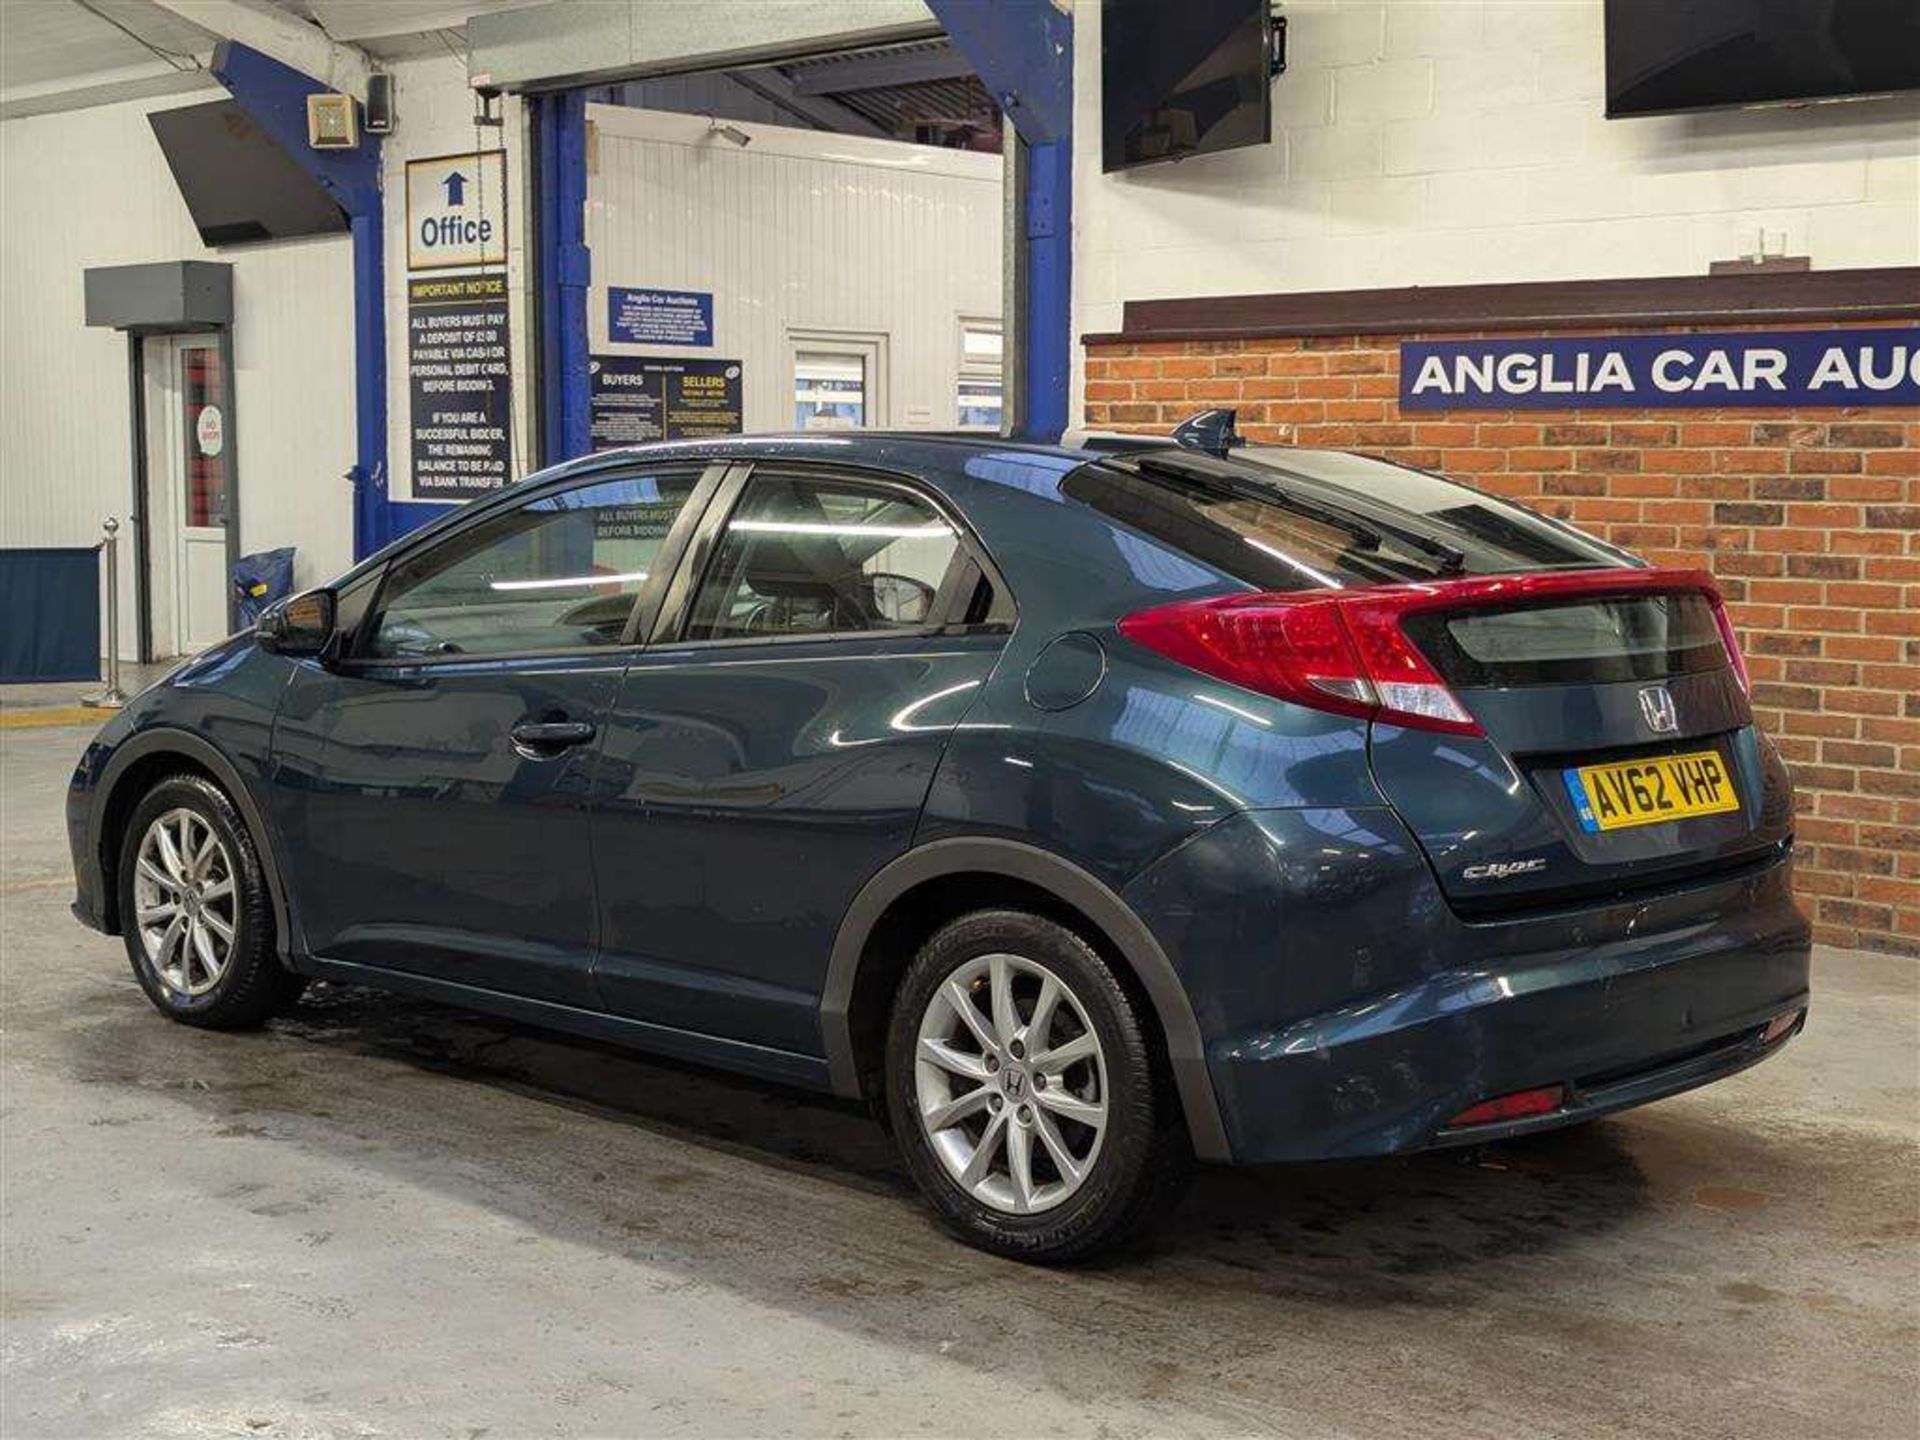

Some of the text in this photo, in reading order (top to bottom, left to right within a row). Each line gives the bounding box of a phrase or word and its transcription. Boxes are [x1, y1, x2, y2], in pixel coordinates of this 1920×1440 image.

[420, 216, 492, 247] Office
[412, 280, 503, 297] IMPORTANT NOICE
[411, 317, 427, 328] ALL
[428, 315, 460, 328] BUYERS
[487, 313, 505, 325] PAY
[419, 334, 426, 344] A
[427, 331, 462, 344] DEPOSIT
[463, 331, 475, 343] OF
[413, 348, 449, 360] PAYABLE
[451, 348, 465, 359] VIA
[491, 346, 505, 358] OR
[410, 364, 453, 376] PERSONAL
[454, 363, 480, 375] DEBIT
[1411, 345, 1920, 396] ANGLIA CAR AU
[423, 381, 456, 393] BEFORE
[602, 374, 725, 388] BUYERS SELLERS
[432, 411, 487, 424] IF YOU ARE A
[415, 428, 469, 440] SUCCESSFUL
[428, 444, 493, 456] THE REMAINING
[417, 460, 505, 472] BALANCE TO BE PAID
[419, 476, 503, 488] VIA BANK TRANSFER
[1590, 758, 1722, 820] AV62 VHP
